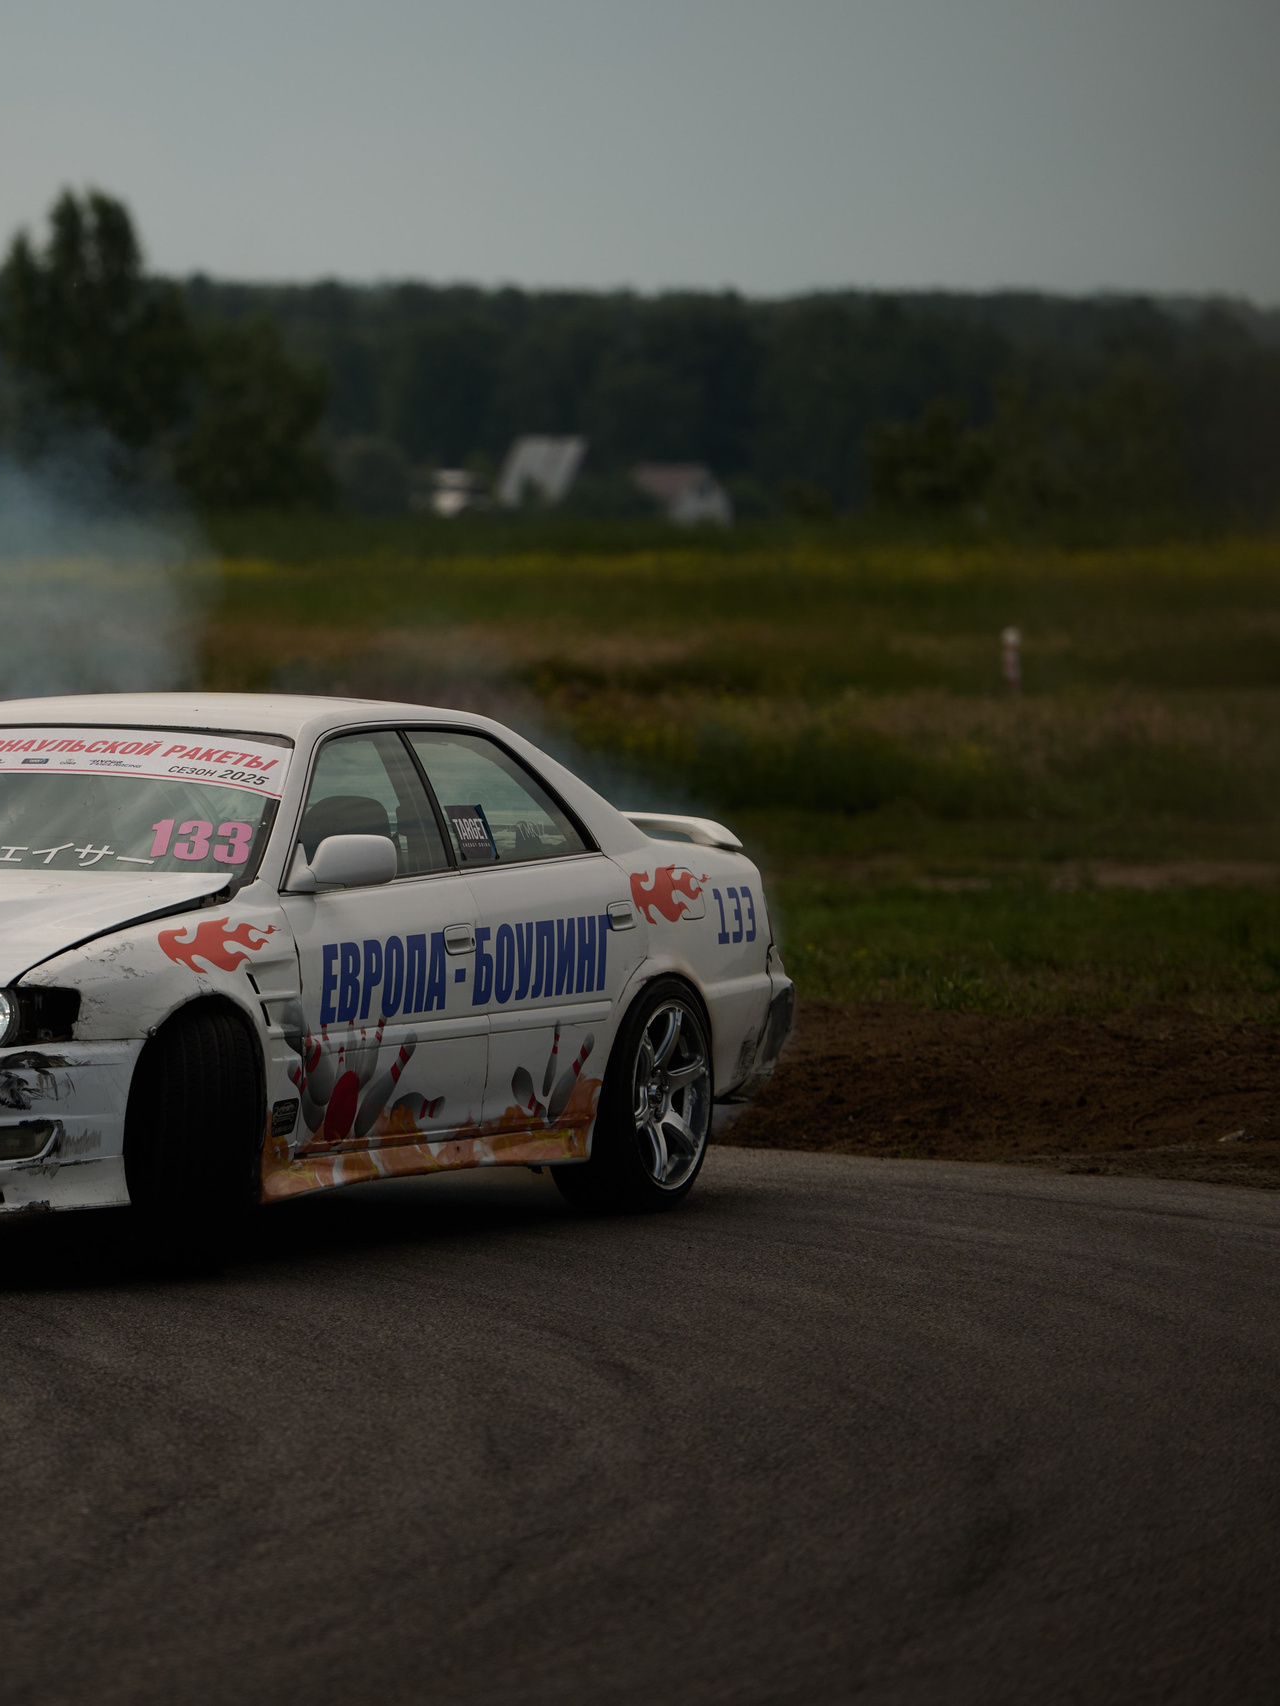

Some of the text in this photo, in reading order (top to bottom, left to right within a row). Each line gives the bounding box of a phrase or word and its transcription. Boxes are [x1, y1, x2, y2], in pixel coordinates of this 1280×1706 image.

[162, 744, 279, 772] РАКЕТЫ
[167, 765, 270, 787] СЕЗОН 2025
[150, 819, 254, 865] 133
[452, 818, 489, 840] TARGET
[712, 885, 757, 945] 133
